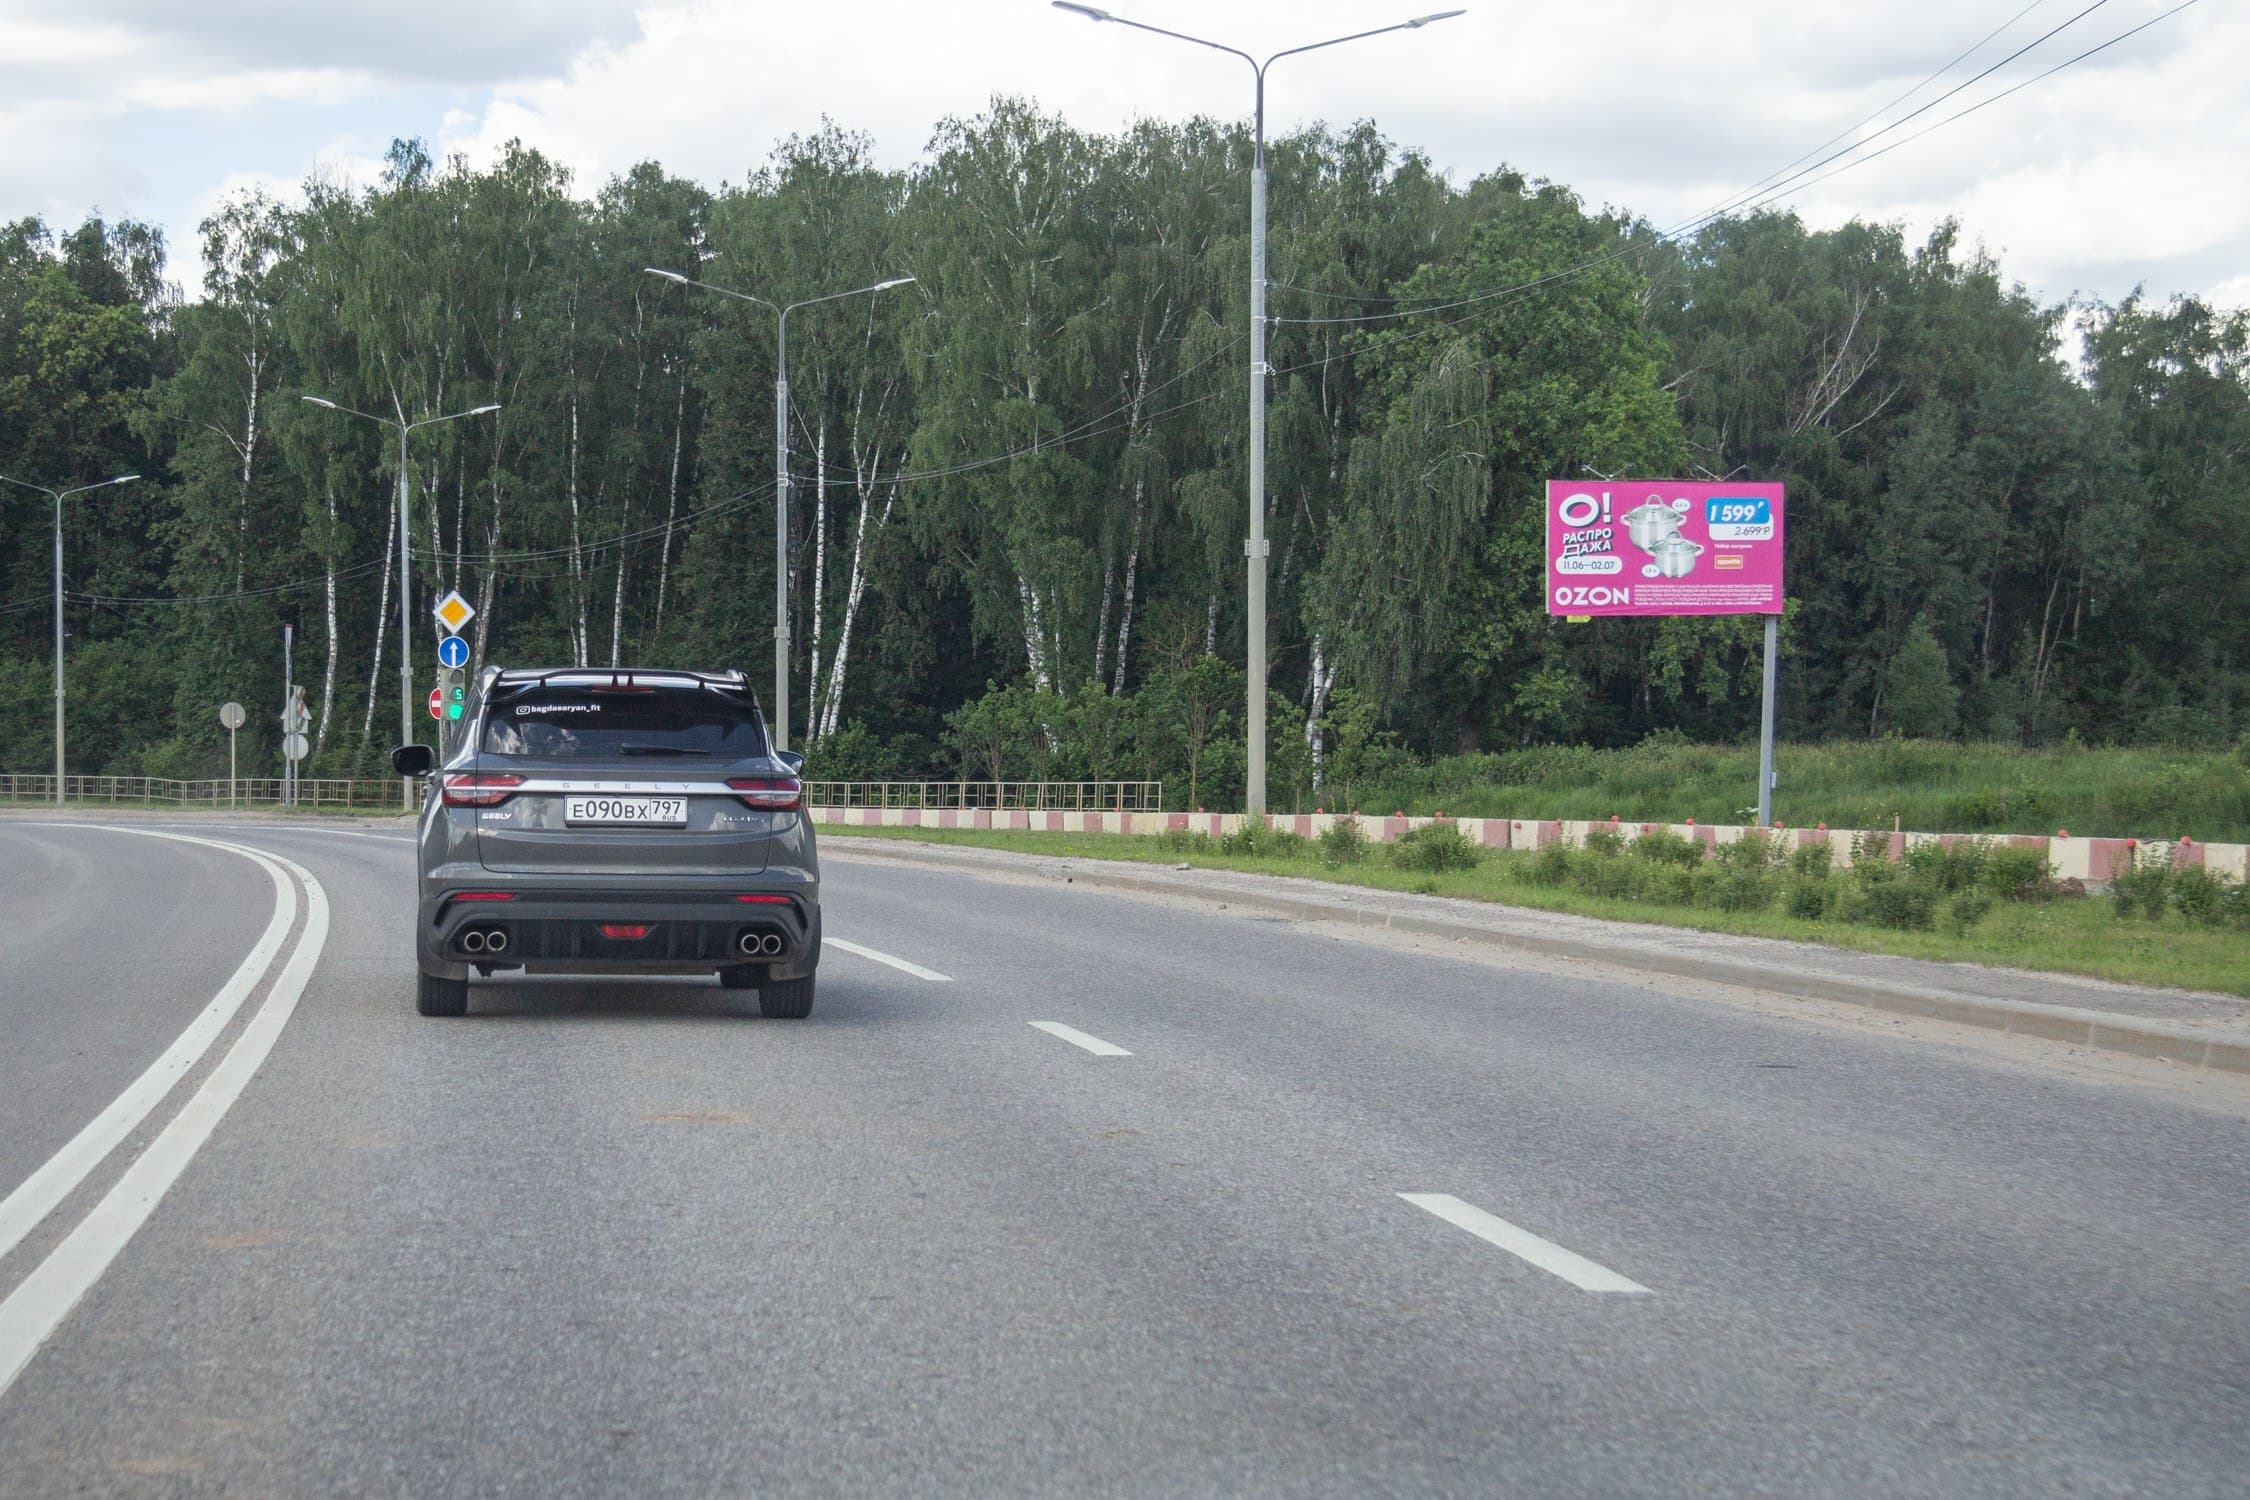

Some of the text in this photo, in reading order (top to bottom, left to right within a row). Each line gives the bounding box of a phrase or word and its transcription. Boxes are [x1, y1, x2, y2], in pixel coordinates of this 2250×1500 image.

[1721, 505, 1756, 521] 599
[1563, 528, 1613, 544] РАСПРО
[1563, 542, 1612, 559] ДАЖА
[1555, 587, 1629, 605] OZON
[481, 812, 513, 820] GEELY
